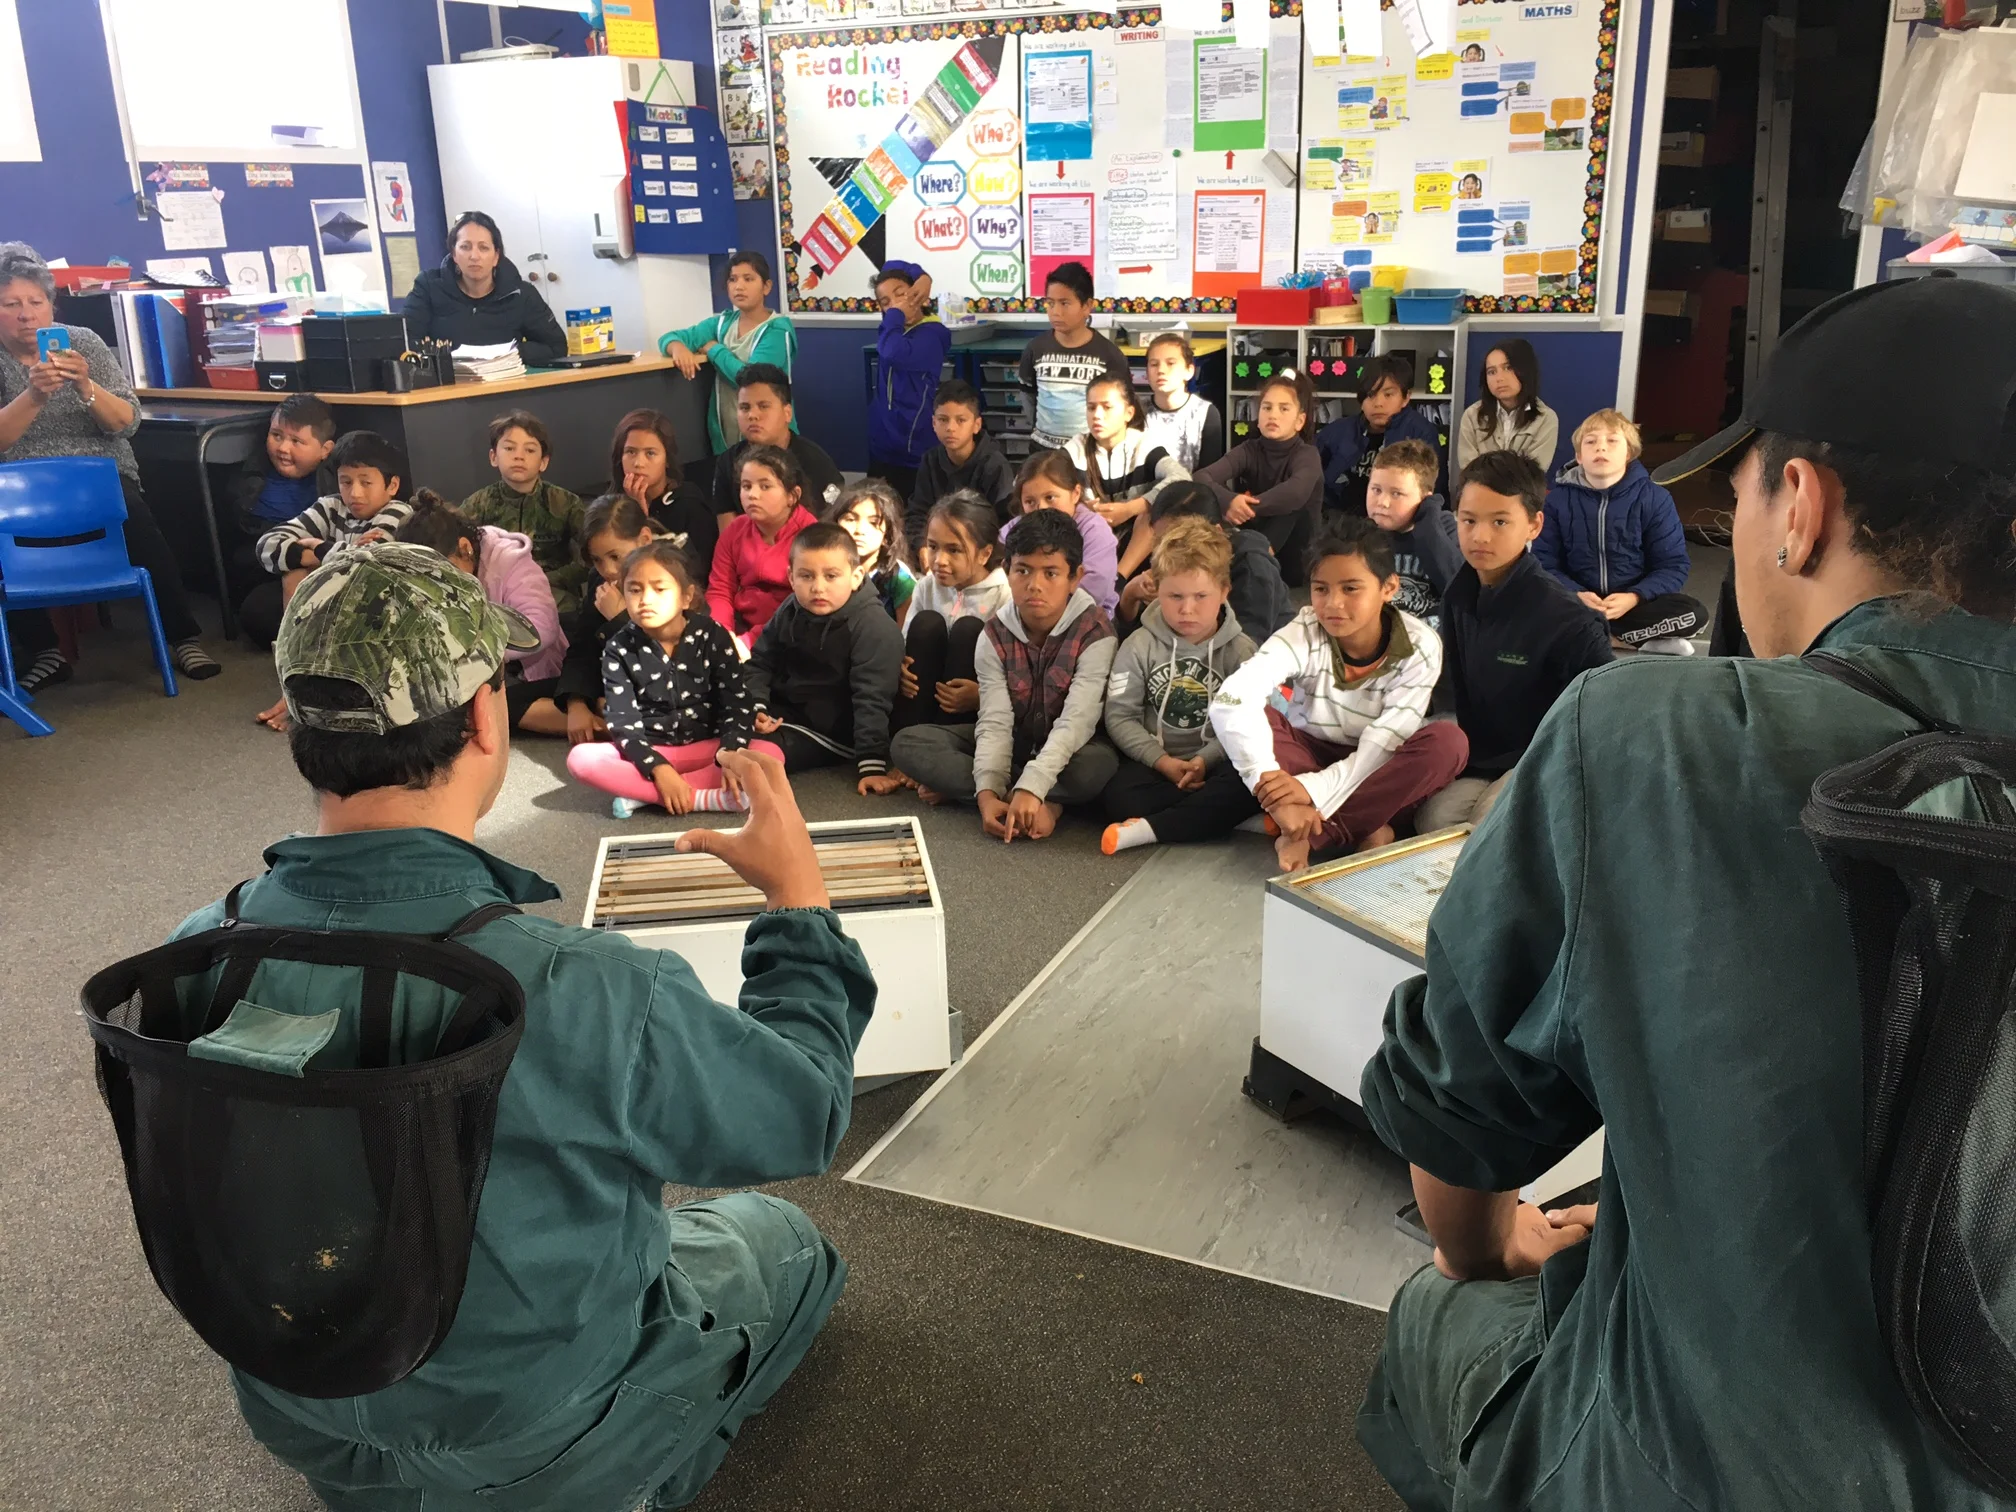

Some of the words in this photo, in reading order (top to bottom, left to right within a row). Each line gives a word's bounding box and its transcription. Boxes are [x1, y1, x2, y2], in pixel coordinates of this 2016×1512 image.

[1525, 5, 1573, 18] MATHS
[1120, 30, 1159, 42] WRITING
[796, 46, 901, 80] Reading
[727, 94, 733, 102] B
[973, 122, 1015, 144] Who?
[920, 172, 961, 194] Where?
[921, 217, 962, 239] What?
[977, 218, 1018, 239] Why?
[977, 263, 1018, 283] When?
[1041, 354, 1100, 365] MANHATTAN
